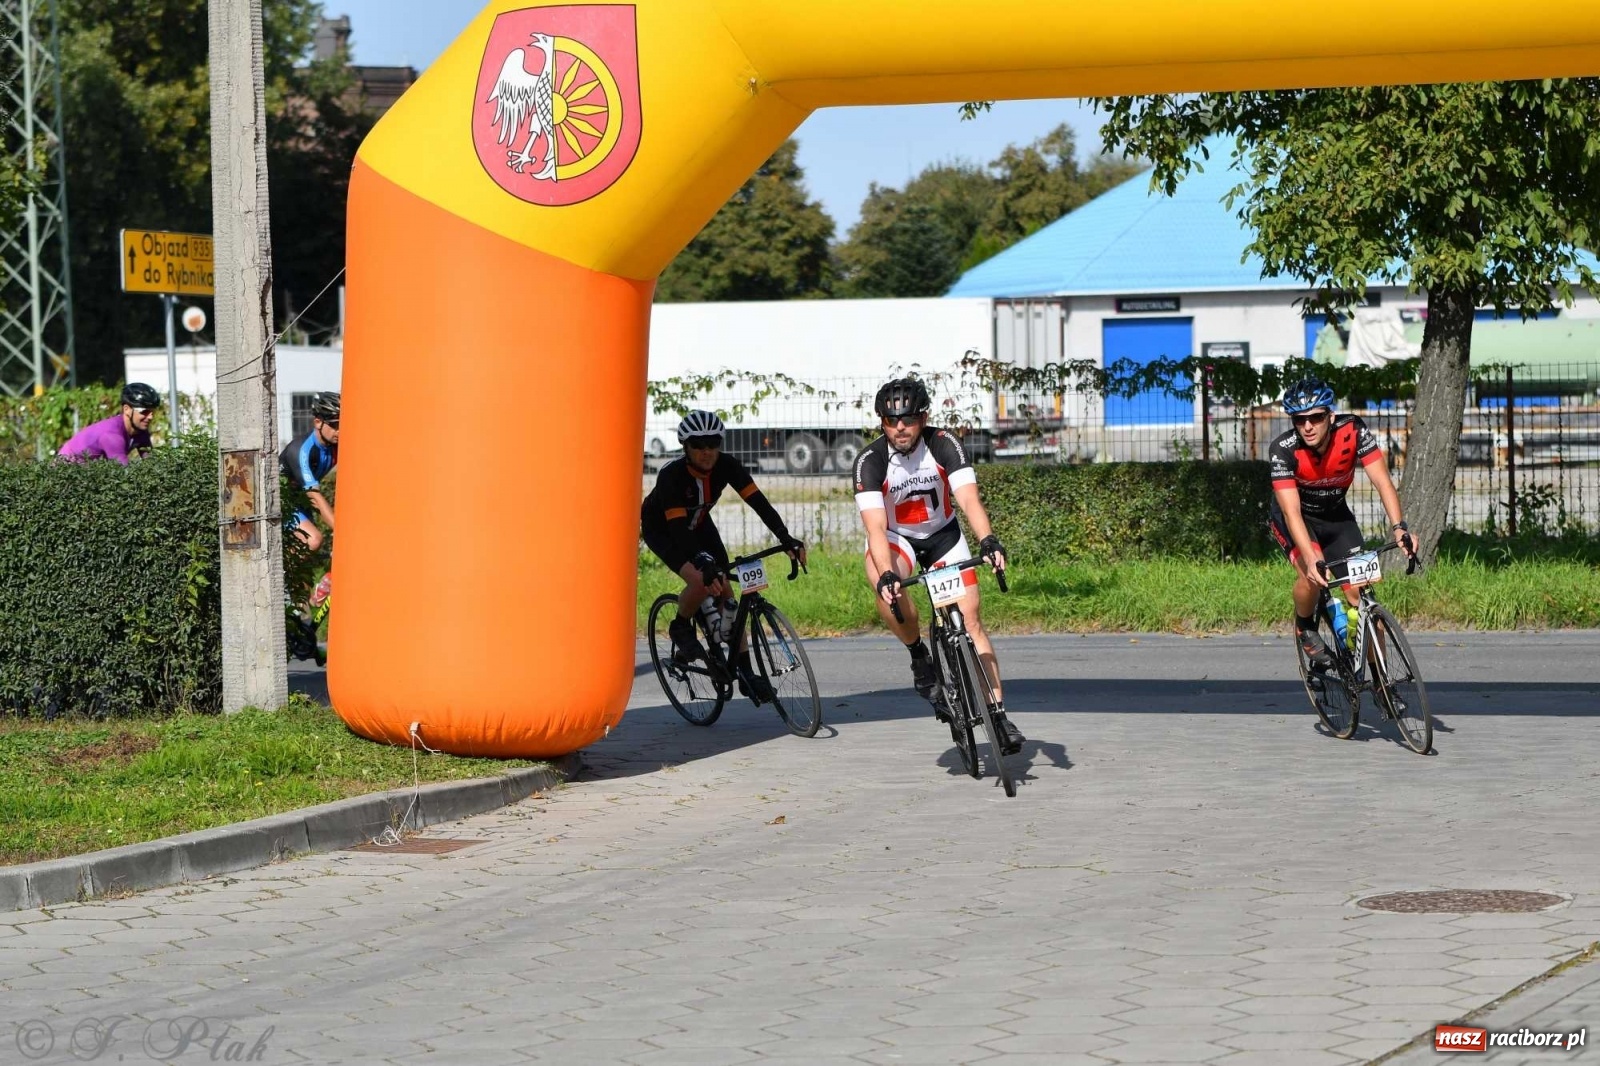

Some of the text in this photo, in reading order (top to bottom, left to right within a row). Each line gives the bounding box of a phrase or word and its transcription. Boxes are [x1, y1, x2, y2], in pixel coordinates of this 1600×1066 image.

[142, 233, 211, 262] Objazd 935
[143, 261, 214, 292] do Rybnika
[742, 568, 763, 583] 099
[1350, 562, 1378, 577] 1140
[931, 577, 960, 595] 1477
